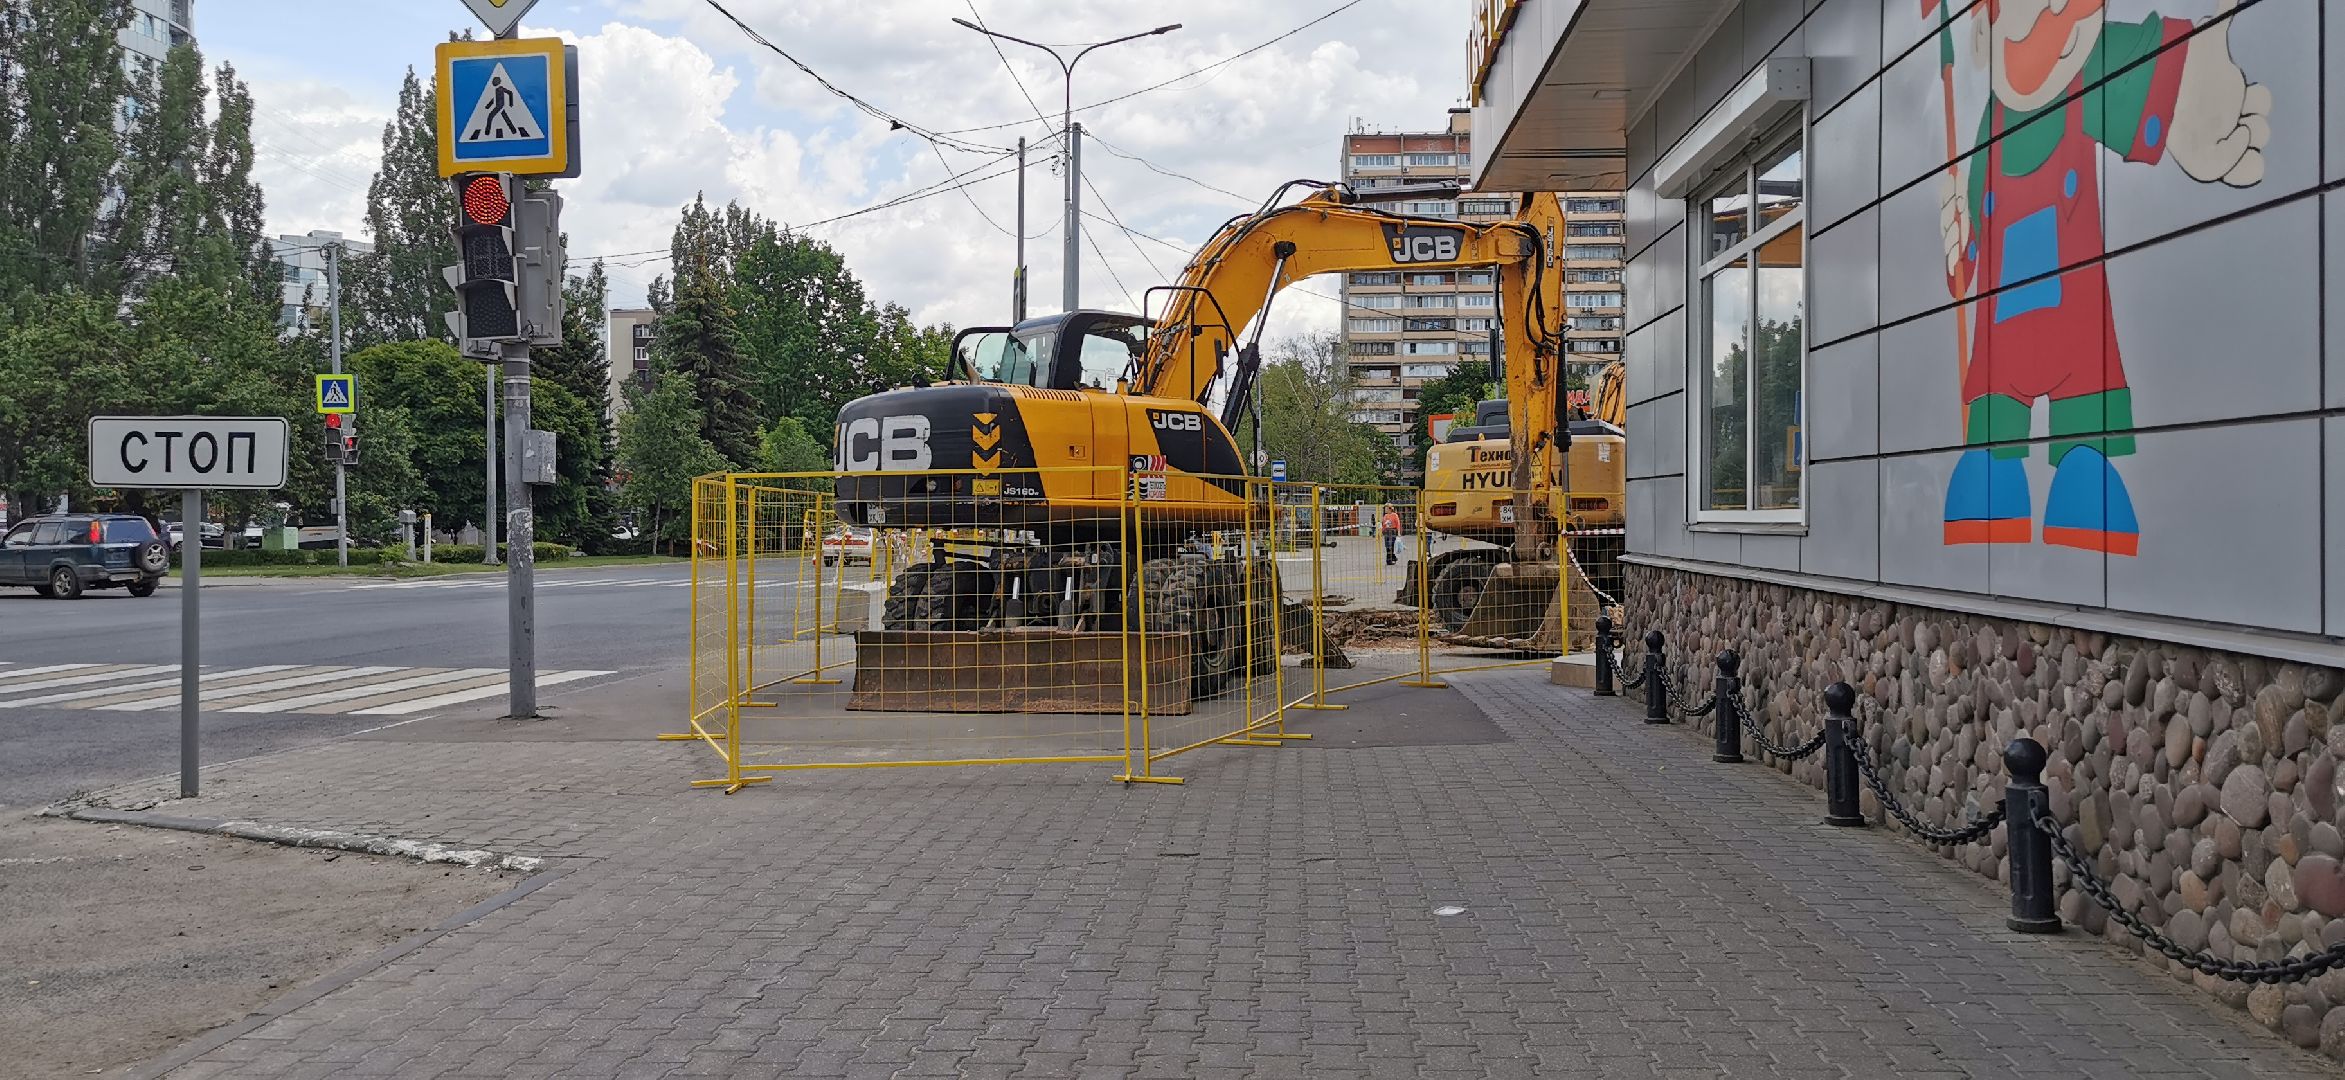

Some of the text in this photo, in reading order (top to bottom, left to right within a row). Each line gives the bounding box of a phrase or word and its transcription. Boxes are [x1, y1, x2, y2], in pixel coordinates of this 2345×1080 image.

[1393, 236, 1457, 262] JCB
[1153, 413, 1201, 431] JCB
[121, 431, 256, 473] СТОП
[833, 415, 932, 473] JCB
